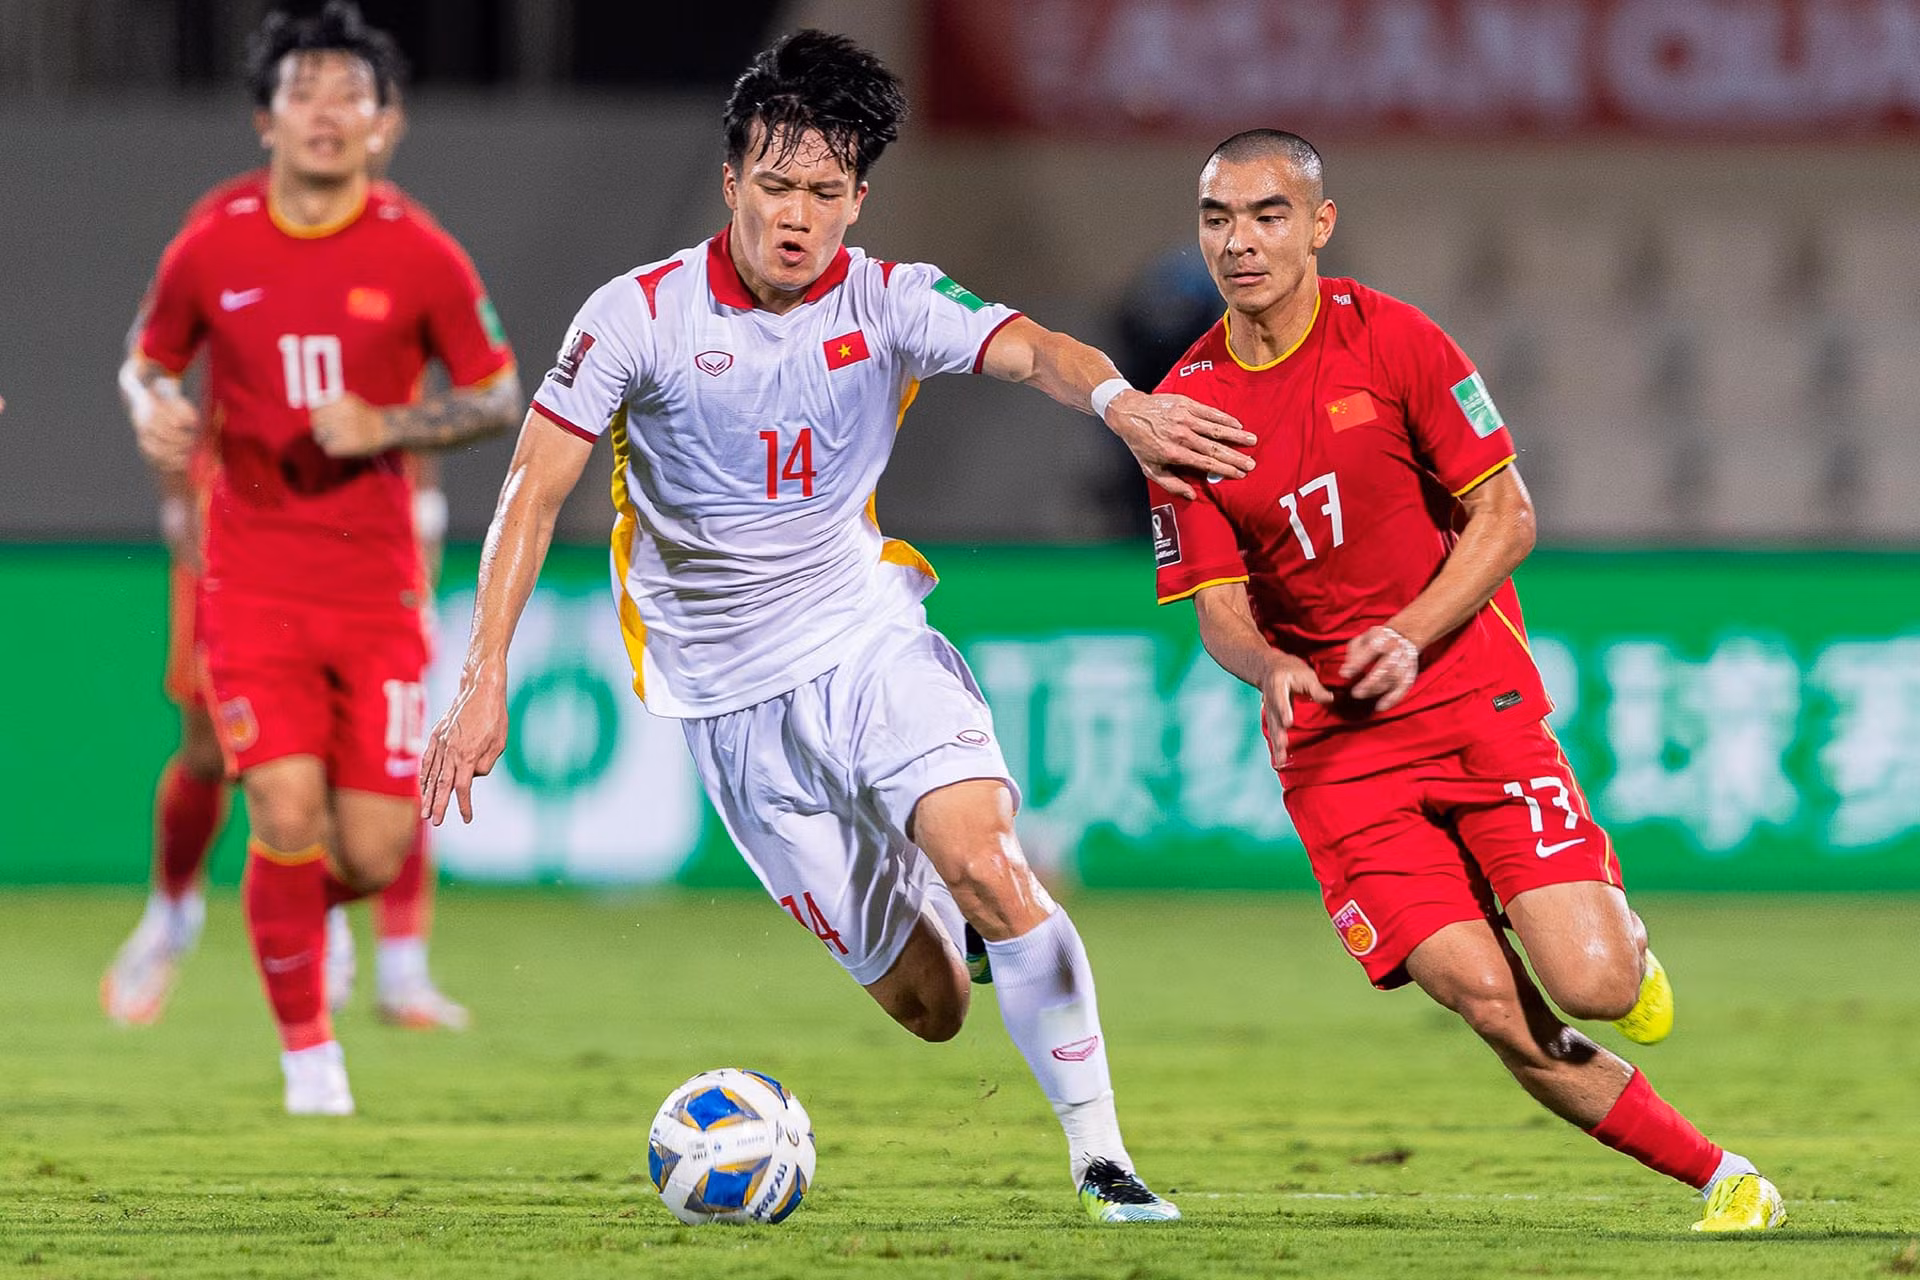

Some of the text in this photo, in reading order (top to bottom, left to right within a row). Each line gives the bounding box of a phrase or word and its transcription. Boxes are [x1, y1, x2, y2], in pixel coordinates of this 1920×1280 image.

[277, 333, 345, 409] 10
[1180, 360, 1213, 377] CFA
[759, 428, 818, 500] 14
[1279, 471, 1344, 560] 17
[1503, 776, 1578, 832] 17
[780, 891, 849, 955] 14
